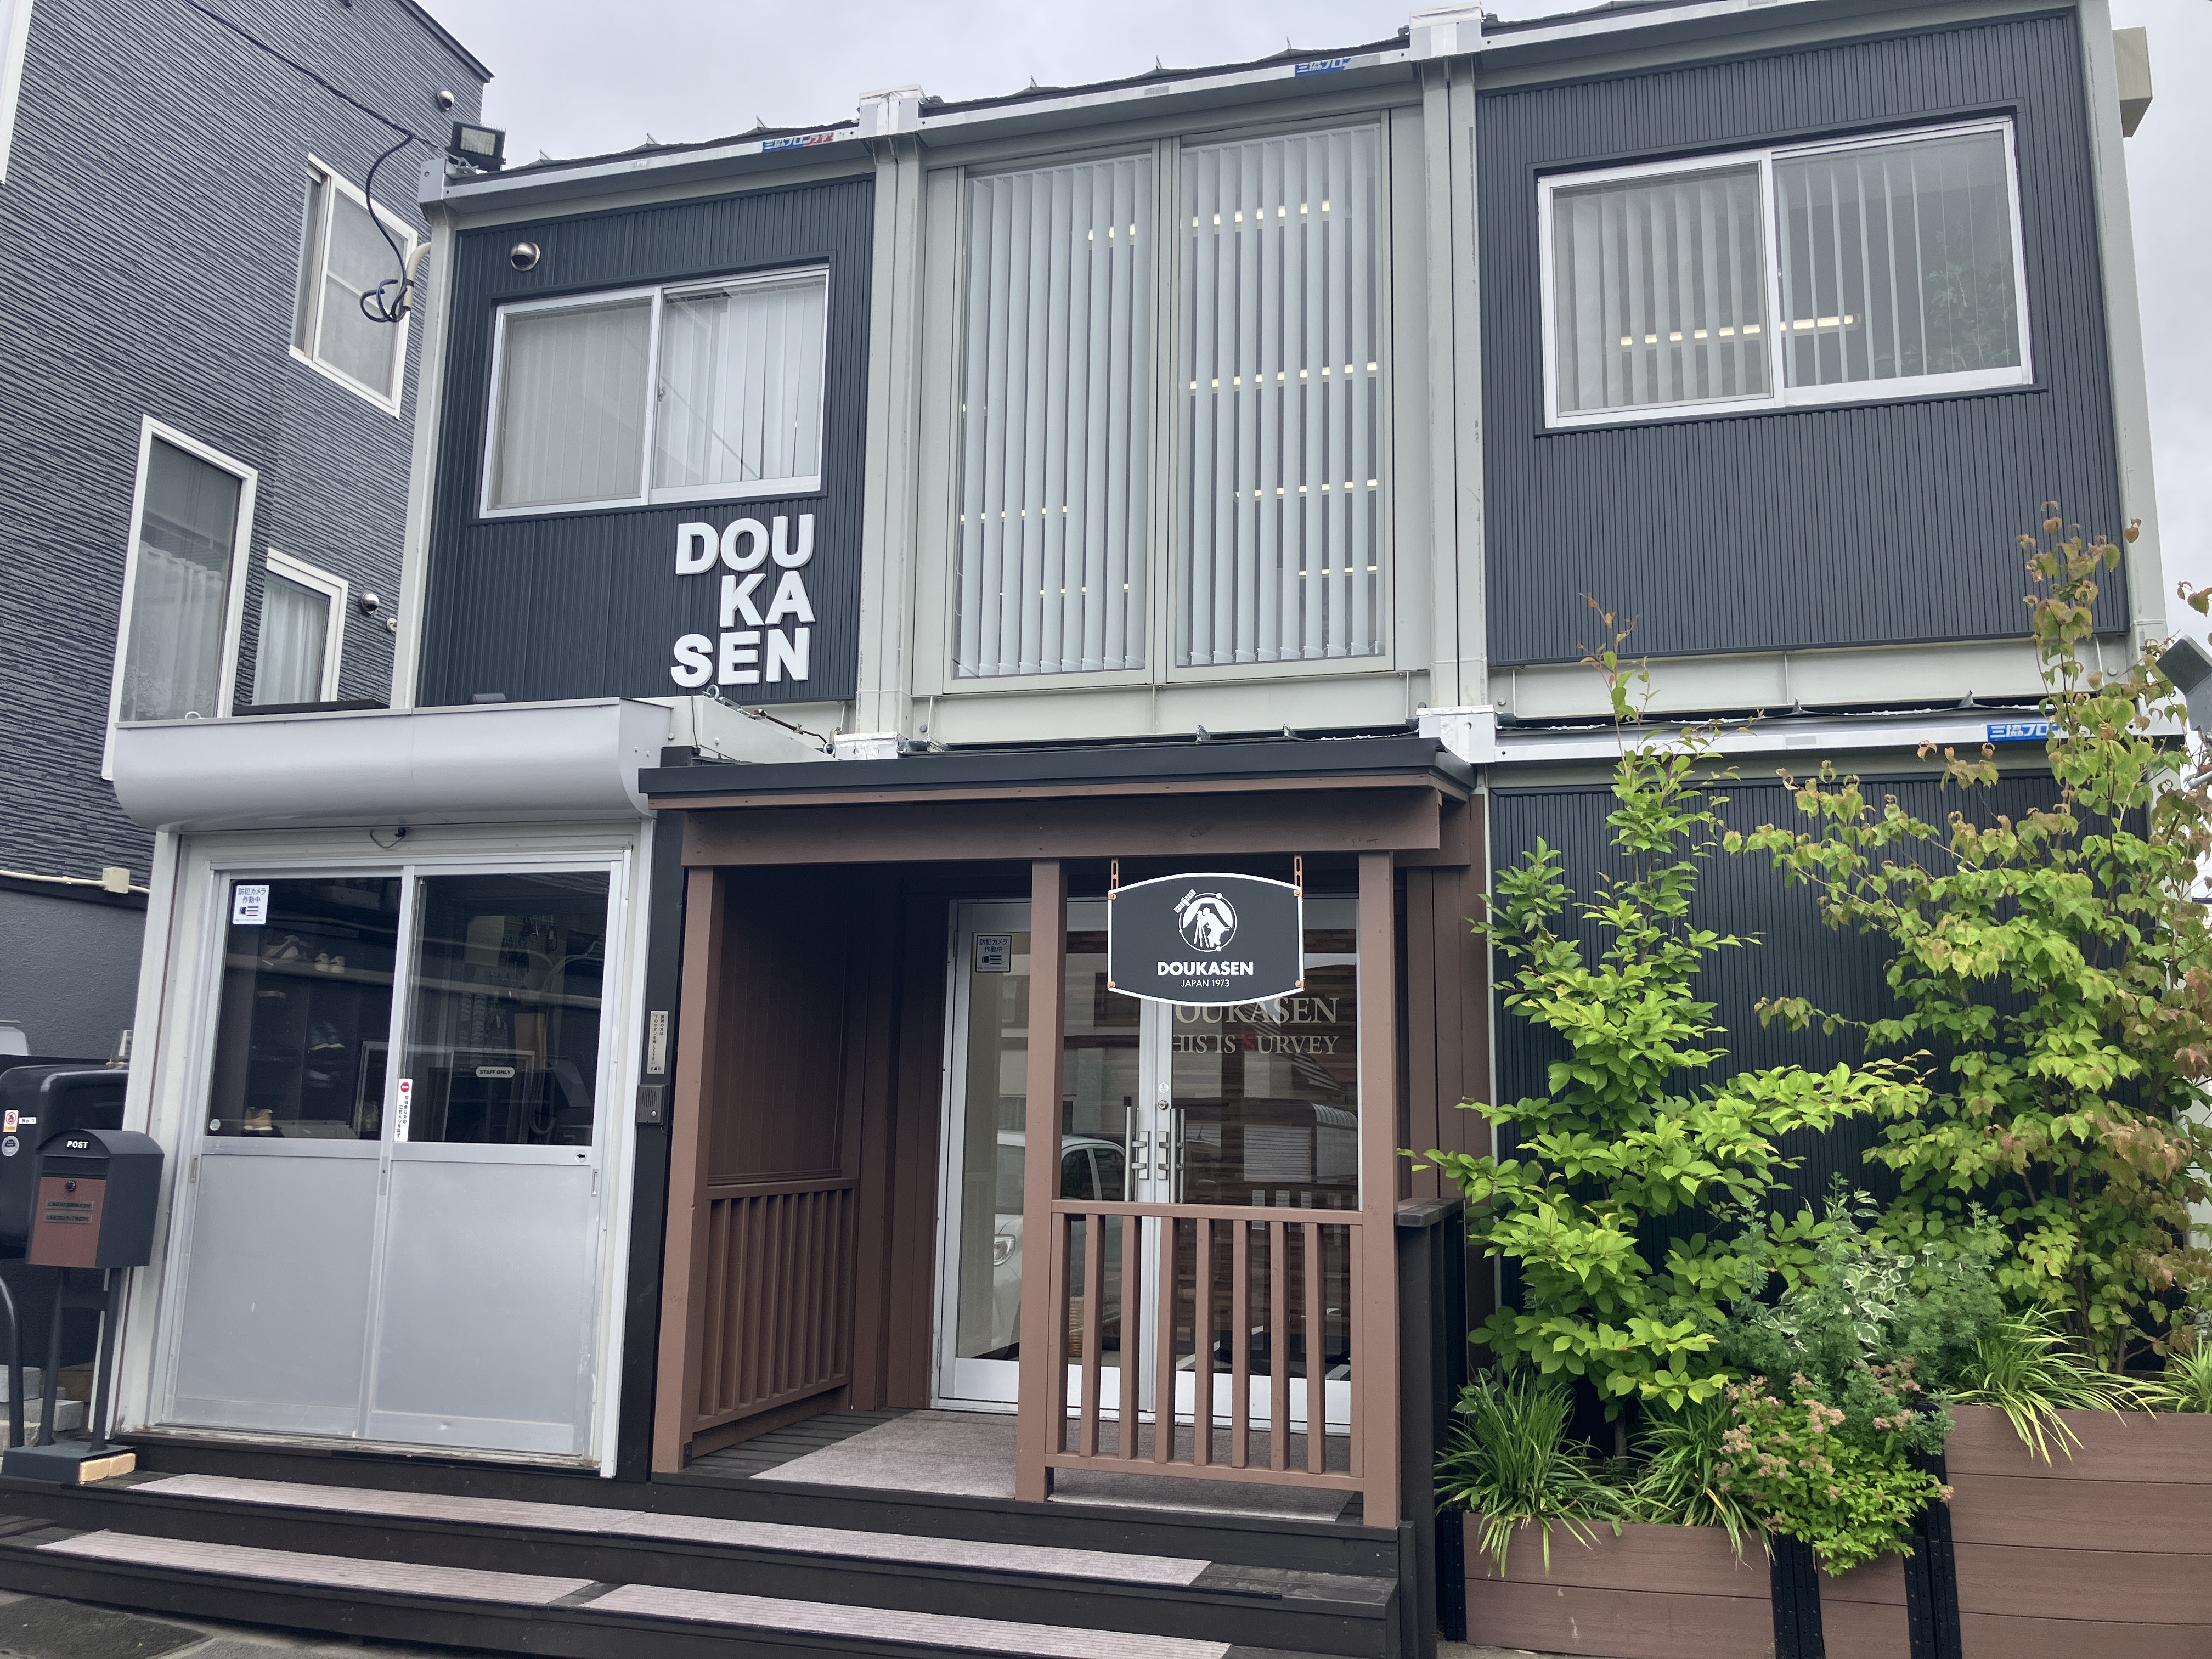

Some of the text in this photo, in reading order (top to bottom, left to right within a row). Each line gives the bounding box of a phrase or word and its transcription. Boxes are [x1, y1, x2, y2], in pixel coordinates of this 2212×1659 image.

[675, 514, 815, 575] DOU
[719, 571, 816, 628] KA
[670, 627, 810, 688] SEN
[1157, 961, 1254, 975] DOUKASEN
[1180, 979, 1230, 988] JAPAN 1973
[1175, 997, 1340, 1024] OUKASEN
[1173, 1034, 1340, 1054] HIS IS SURVEY
